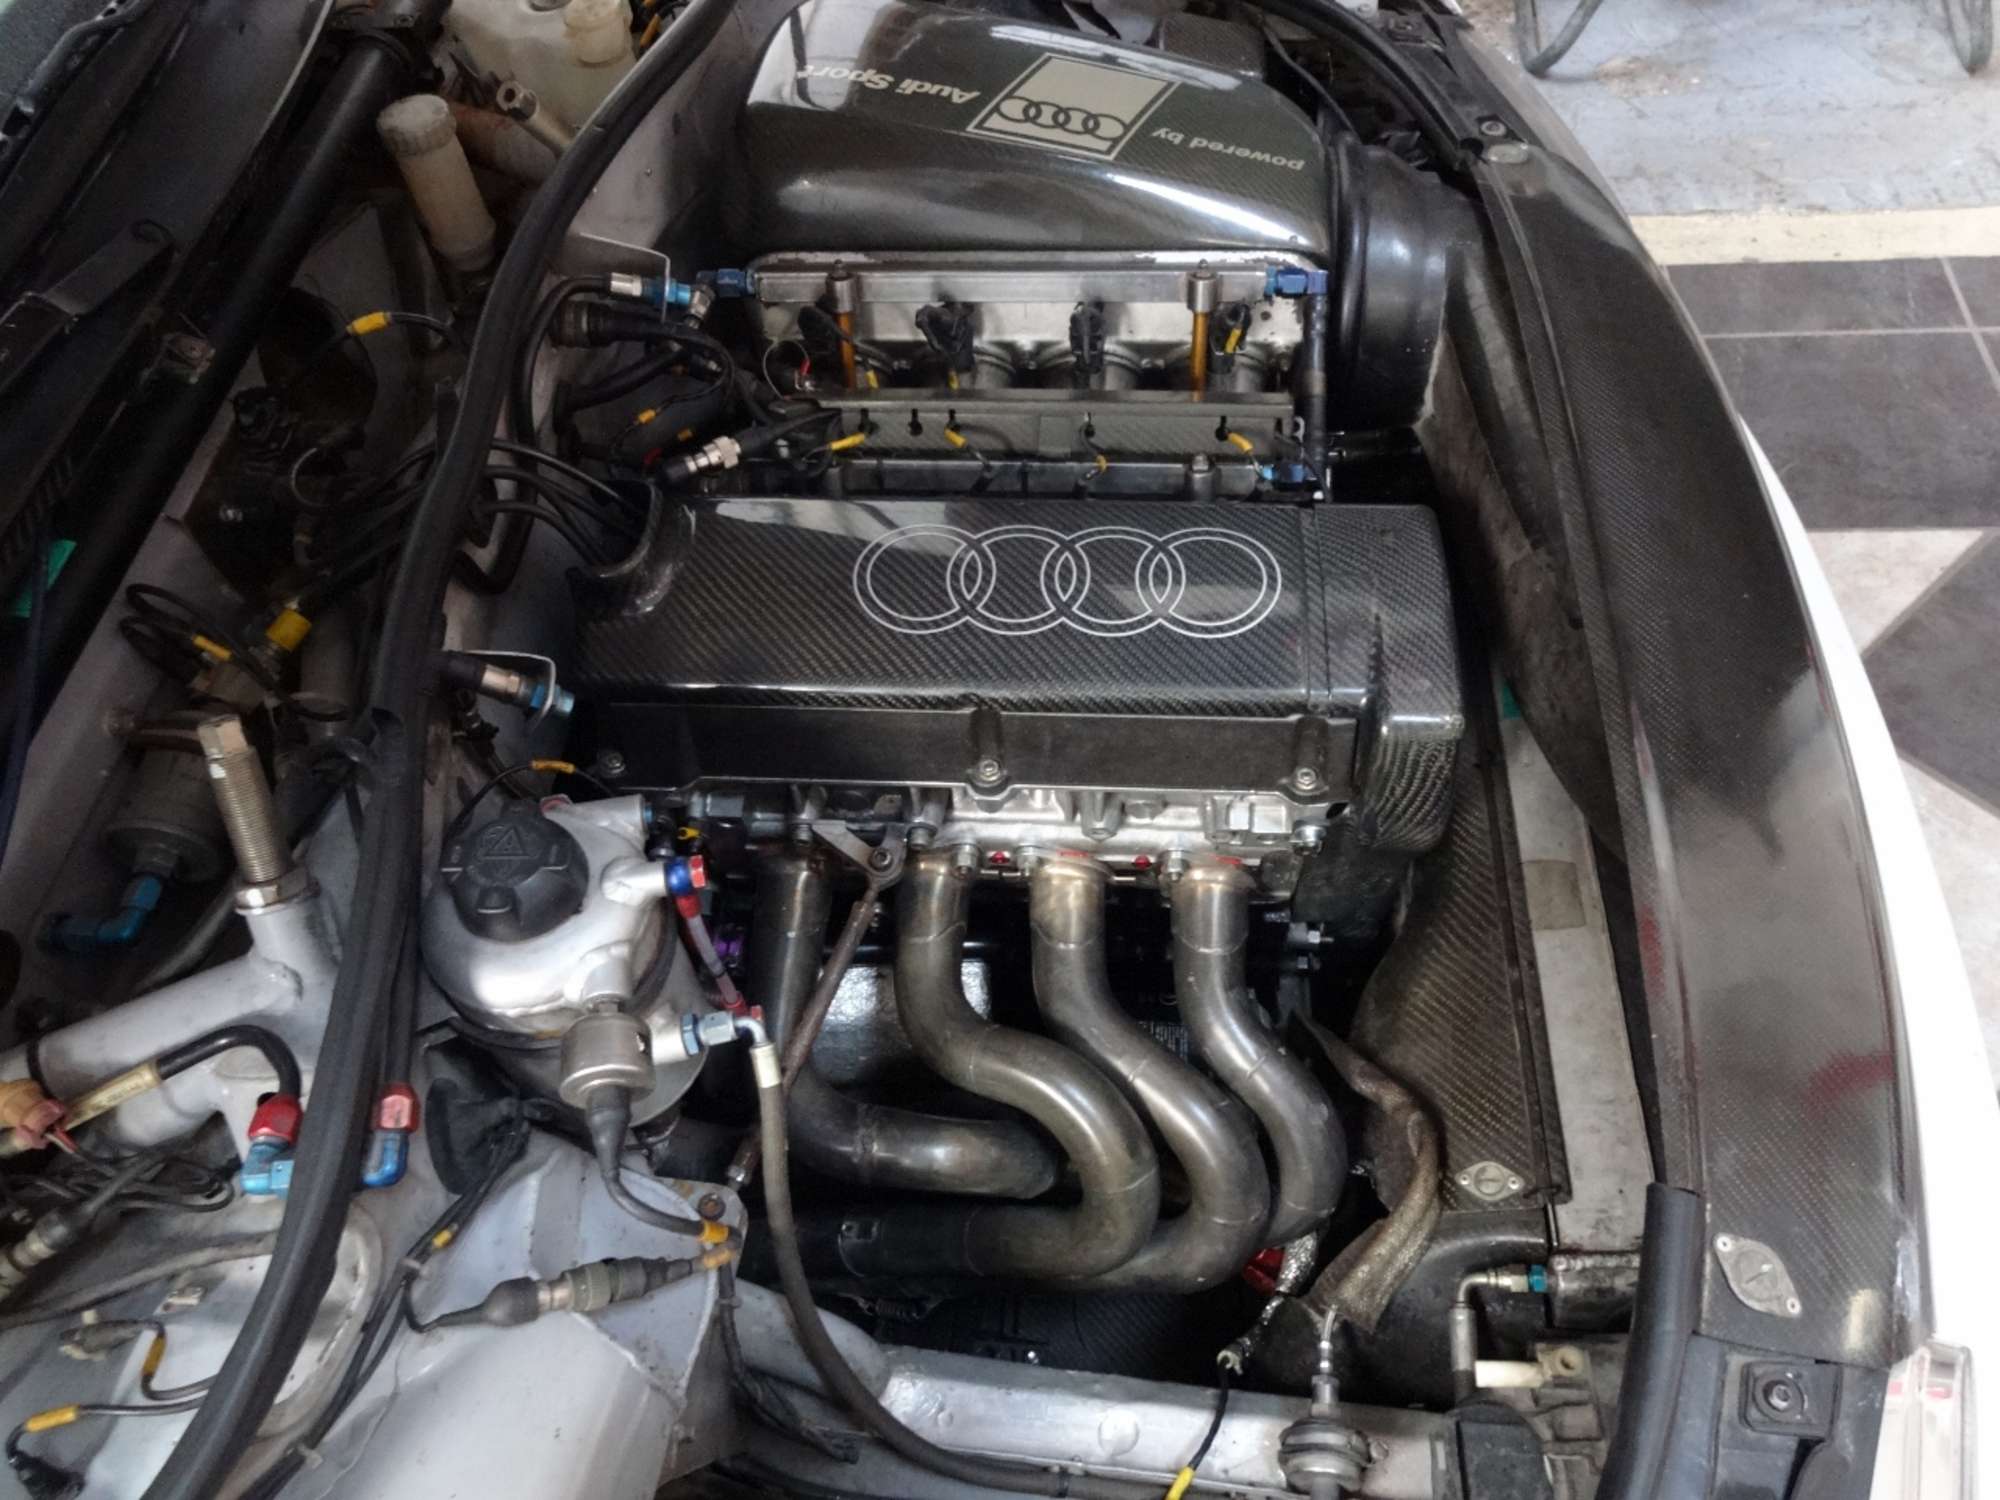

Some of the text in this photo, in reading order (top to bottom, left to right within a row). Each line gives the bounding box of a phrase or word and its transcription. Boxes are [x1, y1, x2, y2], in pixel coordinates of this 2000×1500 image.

[797, 64, 981, 104] Audi Sport
[1152, 127, 1305, 170] powered by
